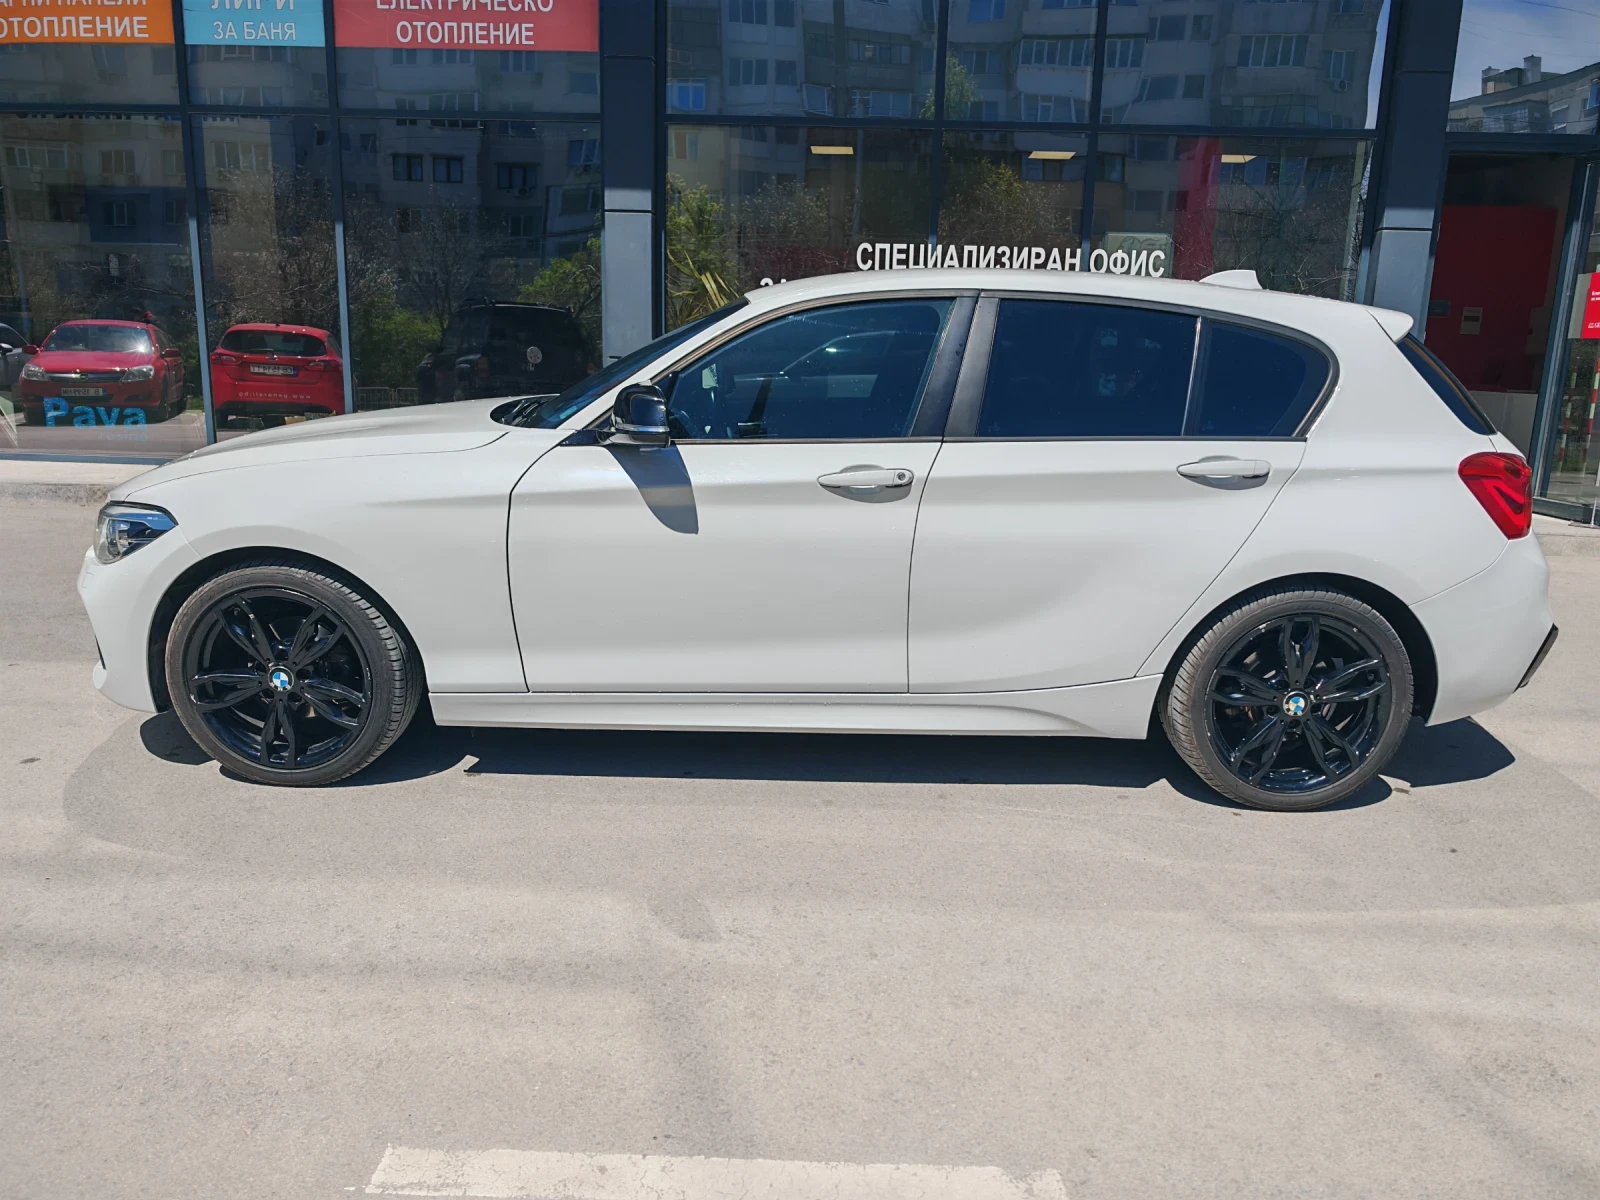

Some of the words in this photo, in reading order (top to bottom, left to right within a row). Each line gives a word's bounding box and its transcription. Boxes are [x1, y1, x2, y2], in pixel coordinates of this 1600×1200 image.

[213, 21, 238, 39] ЗА
[243, 22, 296, 40] БАНЯ
[396, 21, 535, 45] ОТОПЛЕНИЕ
[1089, 248, 1166, 278] ОФИС
[43, 396, 148, 431] Pava
